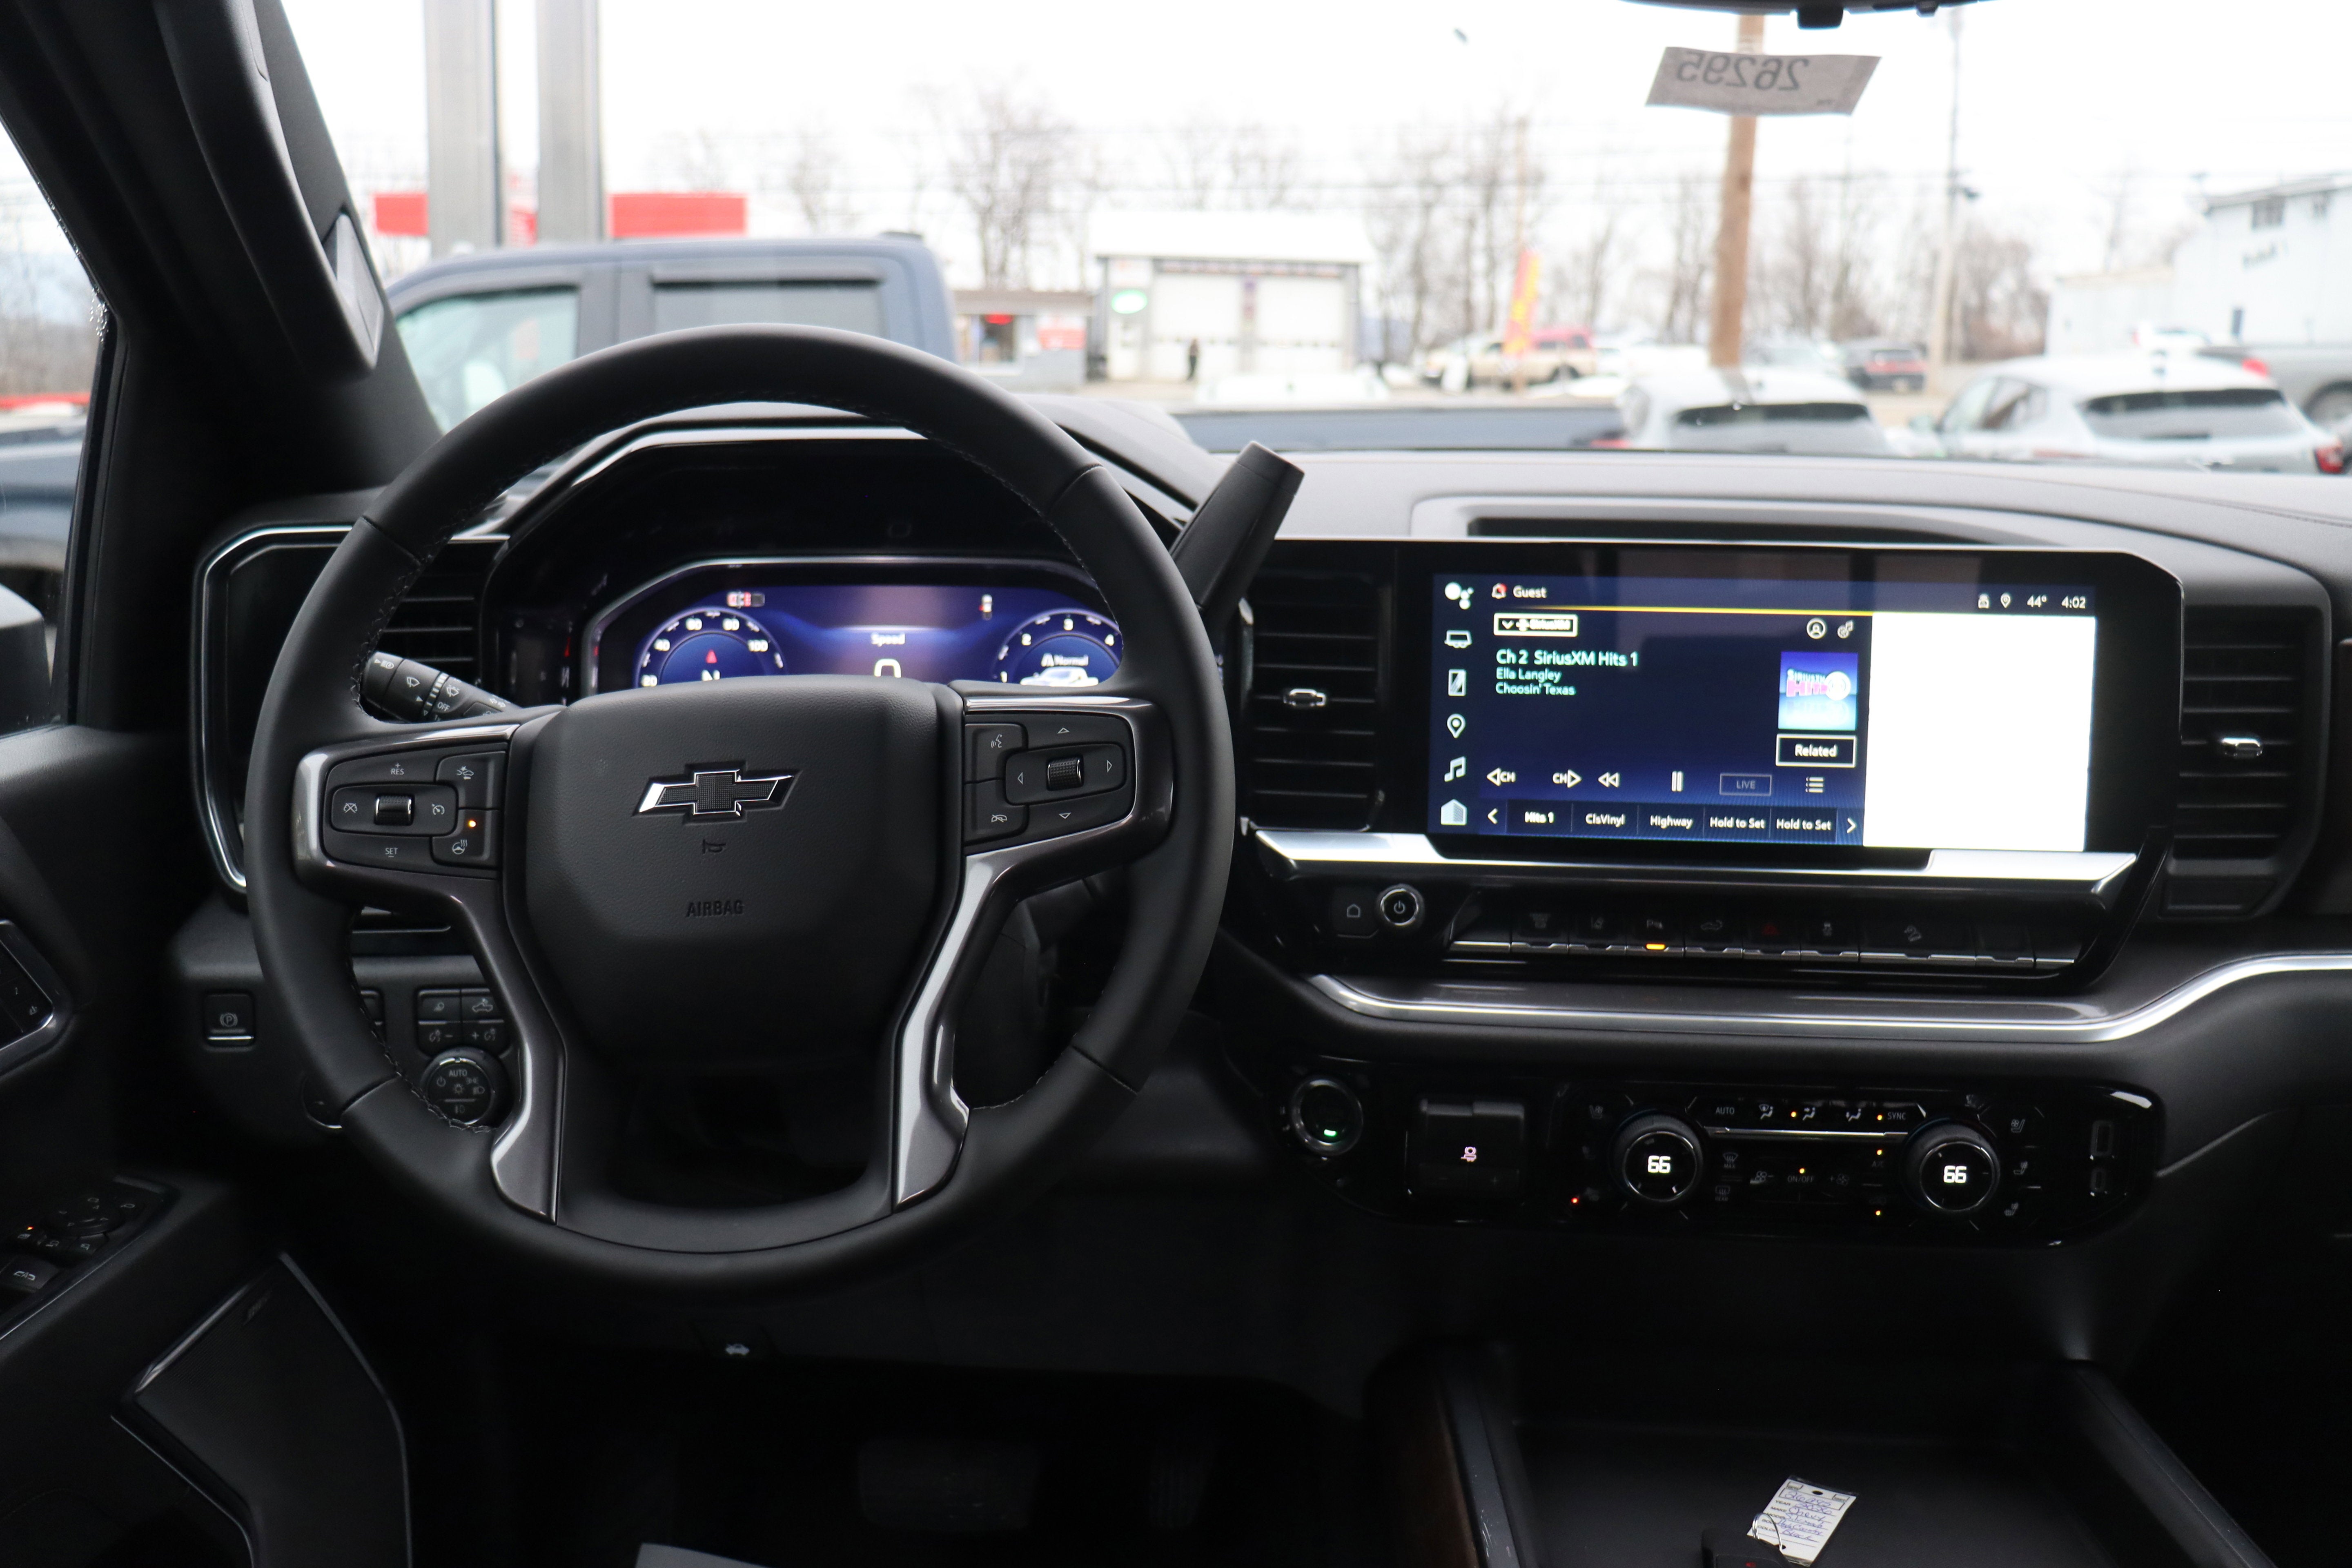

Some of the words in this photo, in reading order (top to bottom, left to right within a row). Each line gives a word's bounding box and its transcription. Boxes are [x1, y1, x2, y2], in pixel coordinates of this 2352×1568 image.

[1513, 585, 1547, 598] Guest
[2062, 595, 2086, 608] 4:02
[748, 639, 768, 652] 100
[1496, 648, 1517, 664] Ch
[1518, 649, 1529, 664] 2
[1534, 650, 1595, 666] SiriusXM
[1598, 651, 1628, 666] Hits
[1630, 651, 1639, 666] 1
[641, 675, 657, 687] 20
[1496, 667, 1517, 679] Ella
[1518, 668, 1562, 683] Langley
[1495, 682, 1542, 695] Choosin'
[1544, 683, 1576, 695] Texas
[437, 702, 450, 711] OFF
[1795, 744, 1838, 757] Related
[1500, 771, 1516, 782] CH
[1552, 773, 1568, 784] CH
[1736, 780, 1756, 790] LIVE
[1524, 811, 1546, 824] Hits
[1548, 811, 1554, 823] 1
[1650, 815, 1693, 829] Highway
[1710, 817, 1733, 828] Hold
[1736, 817, 1746, 829] to
[1748, 817, 1766, 829] Set
[1776, 818, 1799, 829] Hold
[1802, 819, 1813, 830] to
[1815, 819, 1832, 831] Set
[686, 900, 745, 917] AIRBAG
[1715, 1107, 1735, 1115] AUTO
[1887, 1112, 1906, 1120] SYNC
[1648, 1155, 1671, 1173] 66
[1943, 1165, 1967, 1184] 66
